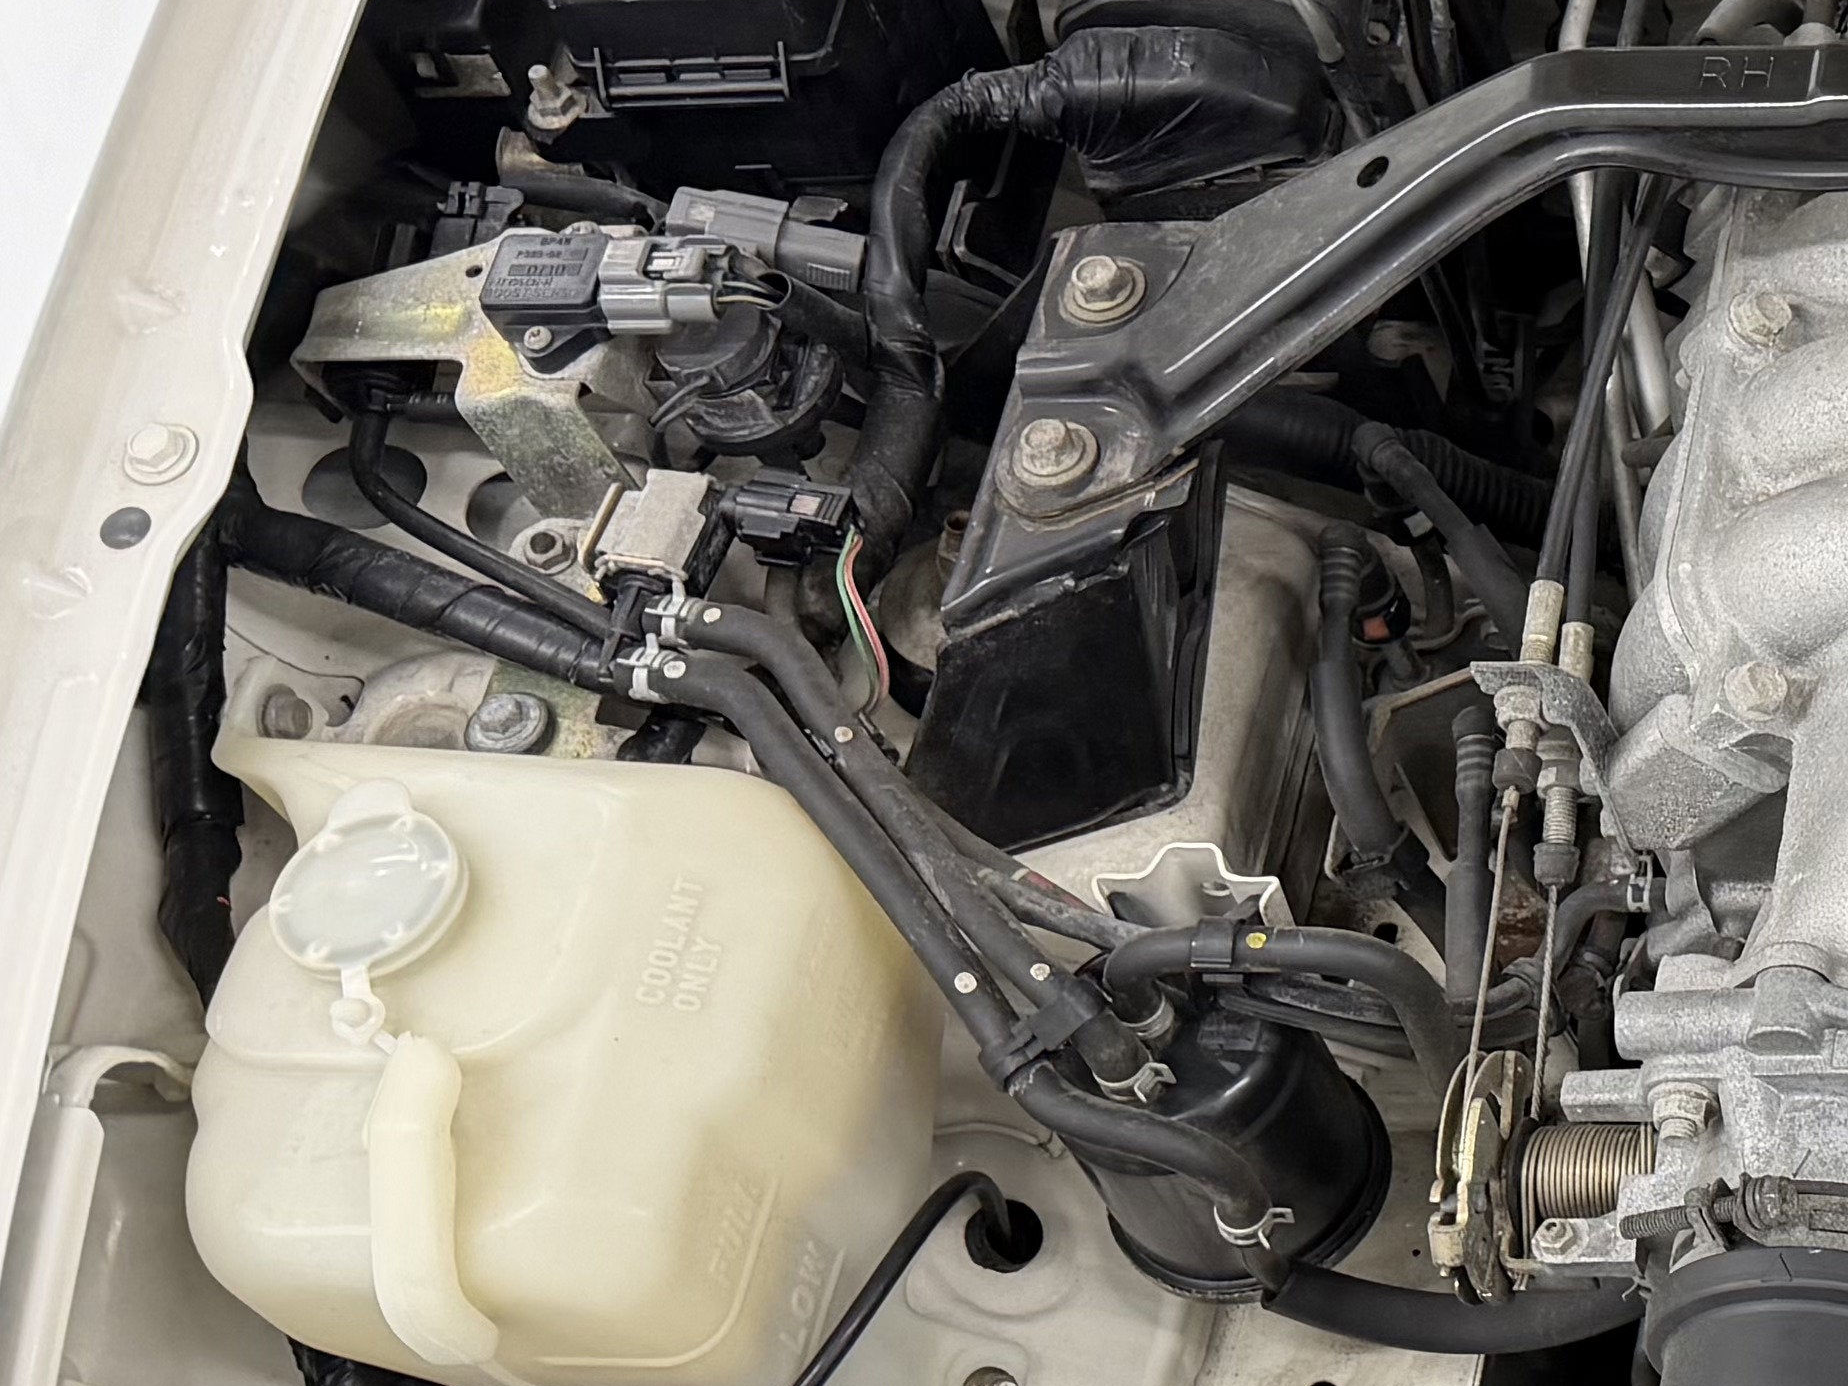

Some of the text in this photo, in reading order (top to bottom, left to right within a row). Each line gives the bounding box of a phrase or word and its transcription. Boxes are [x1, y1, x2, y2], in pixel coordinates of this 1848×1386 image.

[1700, 56, 1774, 88] RH
[636, 872, 704, 1005] COOLANT
[671, 937, 723, 1012] ONLY
[778, 1239, 824, 1352] LOW
